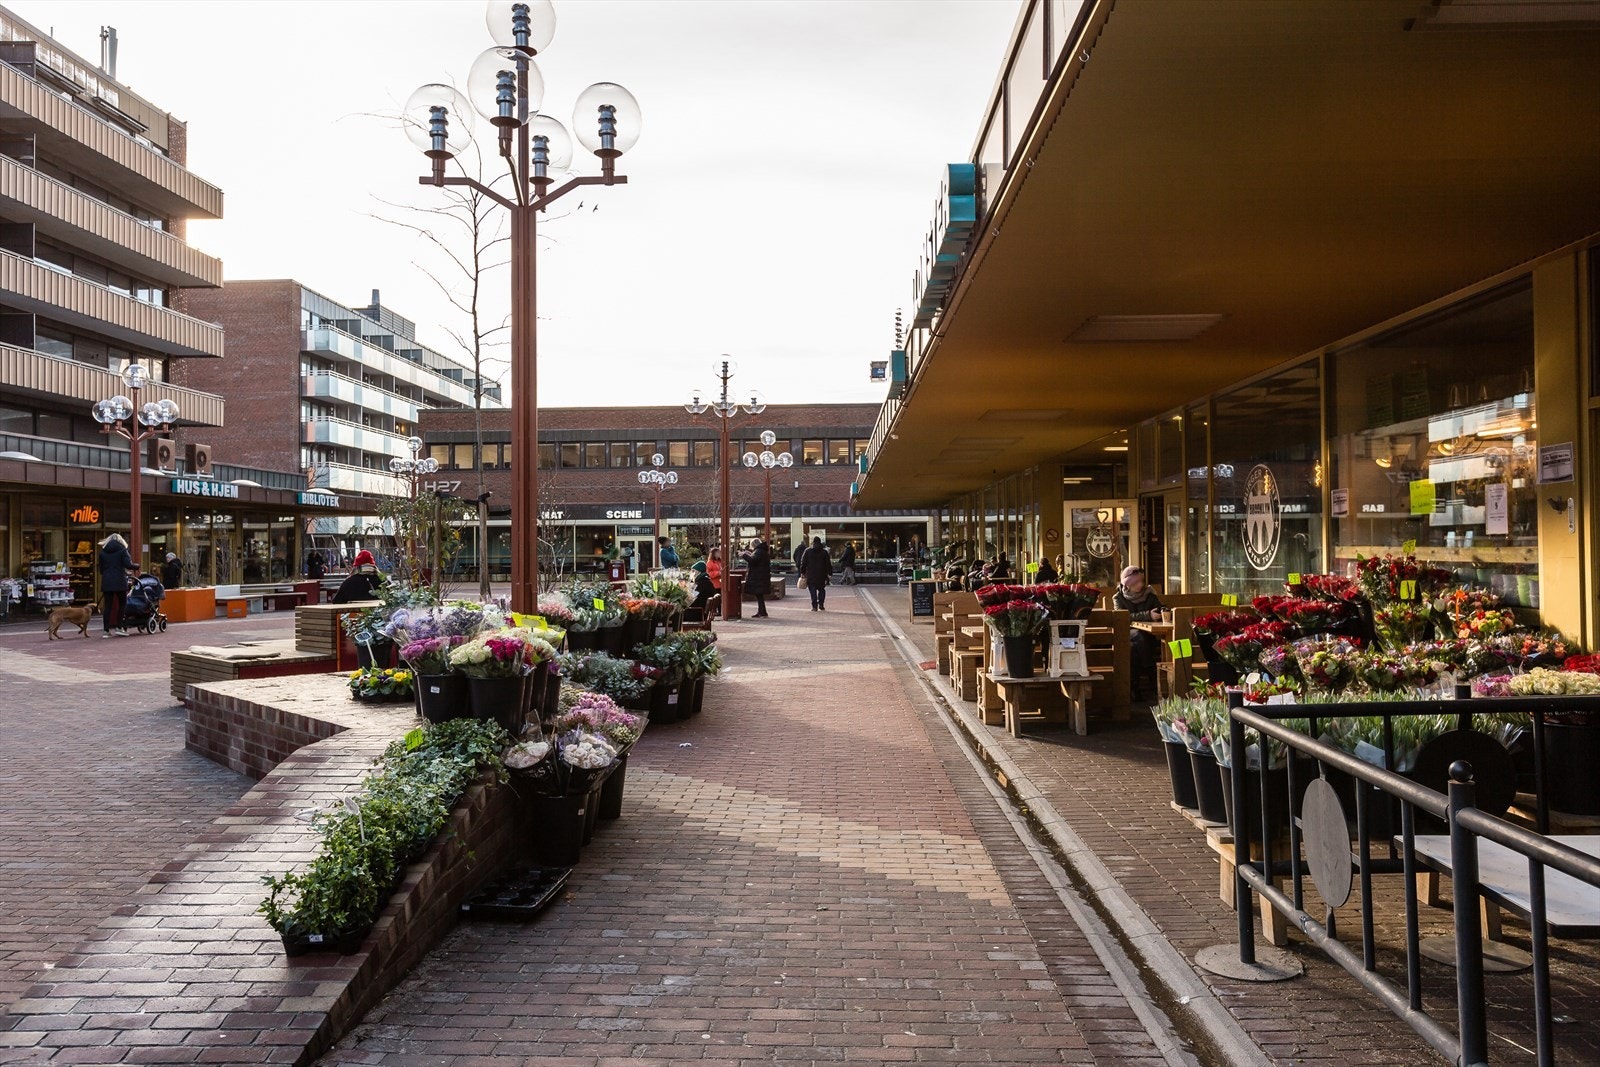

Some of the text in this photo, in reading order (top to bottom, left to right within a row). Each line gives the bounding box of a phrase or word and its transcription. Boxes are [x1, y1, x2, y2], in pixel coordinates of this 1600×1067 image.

[177, 480, 239, 498] HUS & HJEM
[425, 481, 462, 492] H27
[302, 492, 340, 507] BIBLIOTEK
[606, 510, 643, 519] SCENE
[1262, 543, 1275, 564] TORG
